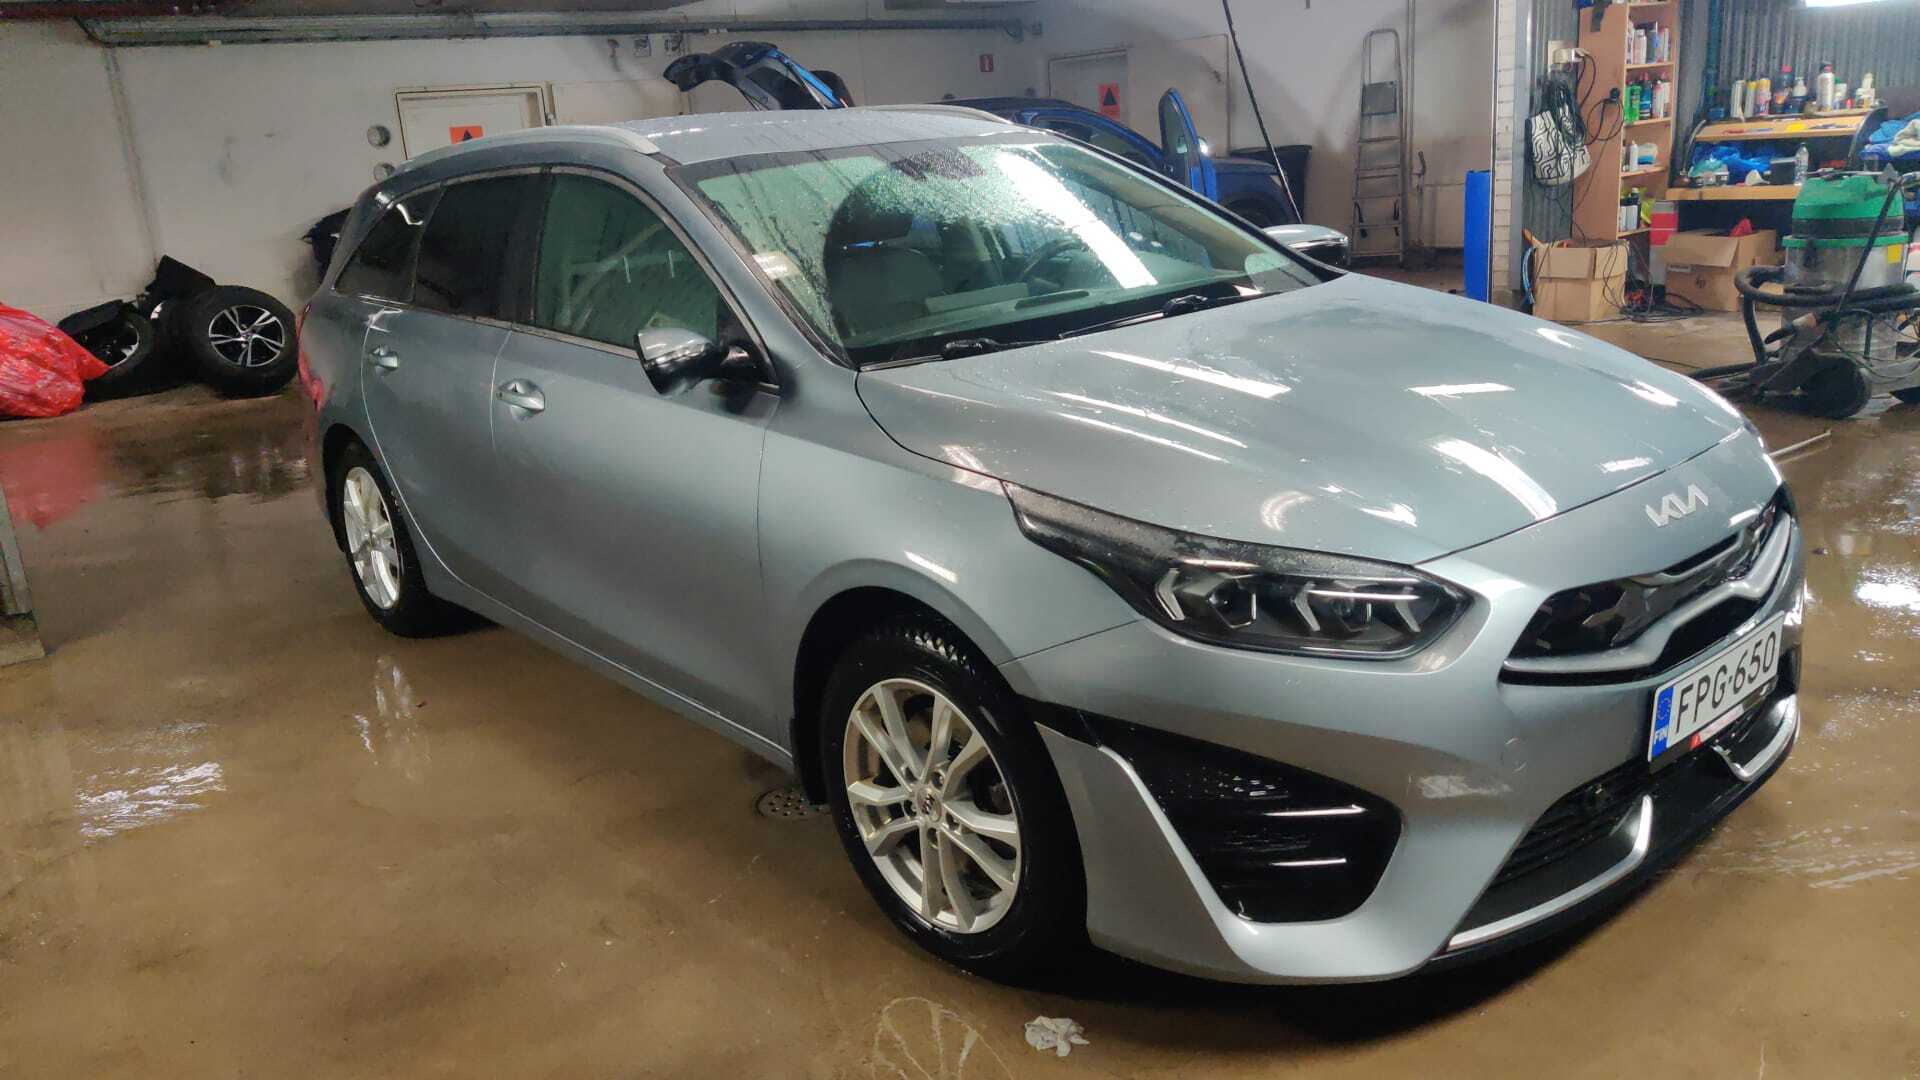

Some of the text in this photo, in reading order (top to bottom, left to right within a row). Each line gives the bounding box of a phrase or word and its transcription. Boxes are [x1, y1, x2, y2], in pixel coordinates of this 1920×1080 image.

[1645, 483, 1709, 527] KIA
[1675, 631, 1777, 734] FPG-650
[1654, 727, 1668, 745] FIN
